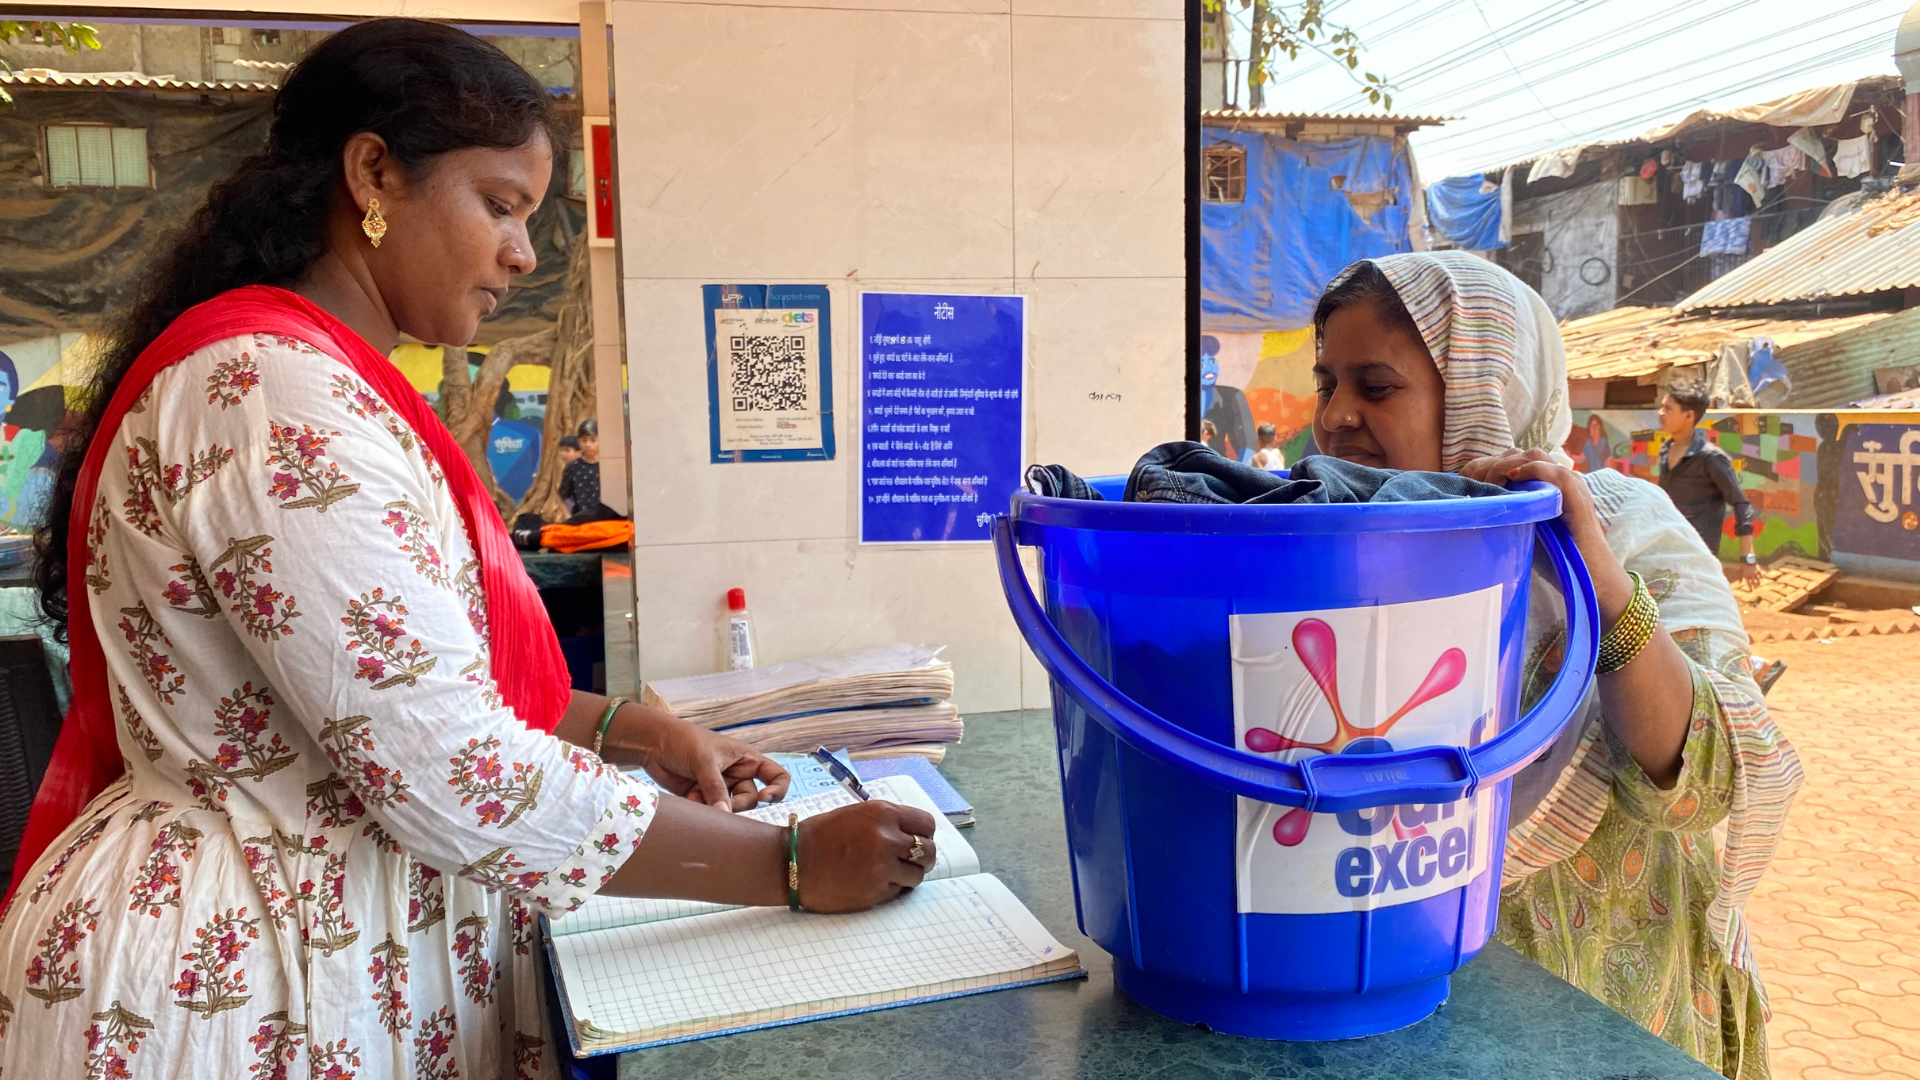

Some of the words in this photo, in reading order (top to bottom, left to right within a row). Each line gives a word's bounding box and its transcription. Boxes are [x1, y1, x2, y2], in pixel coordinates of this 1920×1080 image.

[770, 293, 802, 302] Accepted
[933, 302, 954, 320] नोटीस
[1334, 800, 1475, 898] excel
